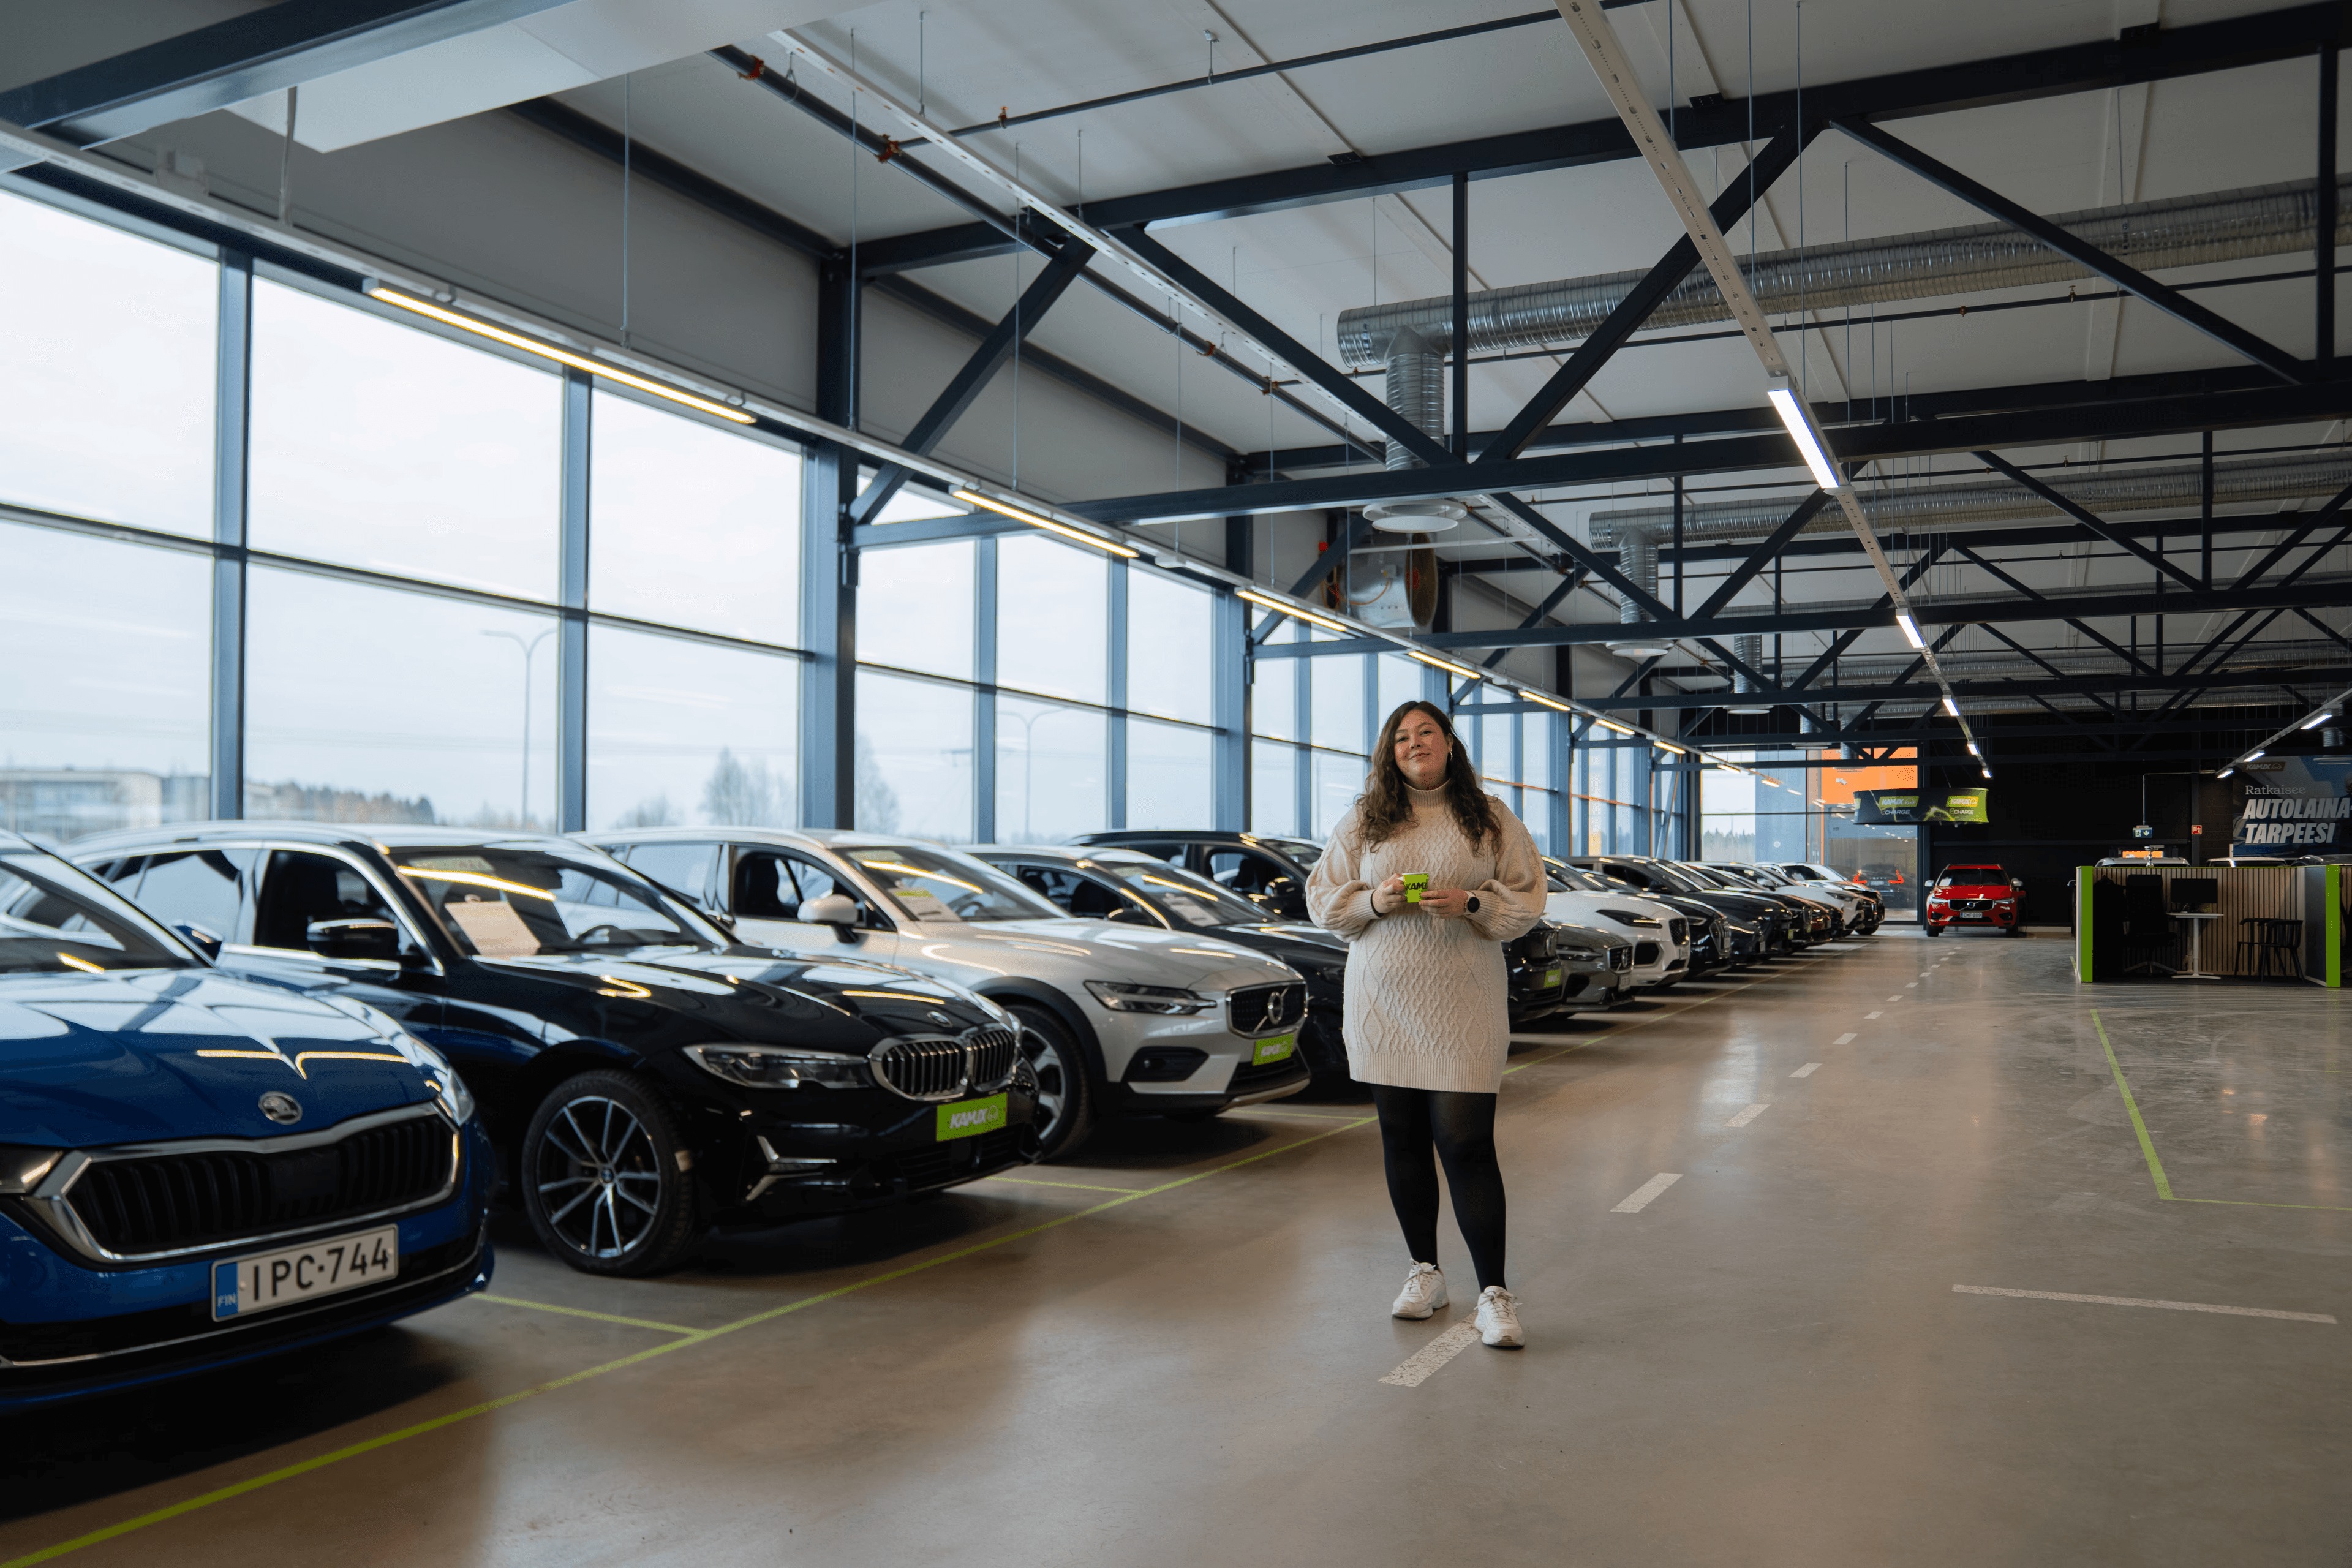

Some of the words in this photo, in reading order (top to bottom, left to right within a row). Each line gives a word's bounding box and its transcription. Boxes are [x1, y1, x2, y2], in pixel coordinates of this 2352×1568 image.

[2245, 785, 2306, 795] Ratkaisee
[2245, 822, 2336, 844] TARPEESI
[1406, 882, 1428, 891] KAMU
[949, 1107, 987, 1129] KAMUX
[217, 1294, 238, 1308] FIN
